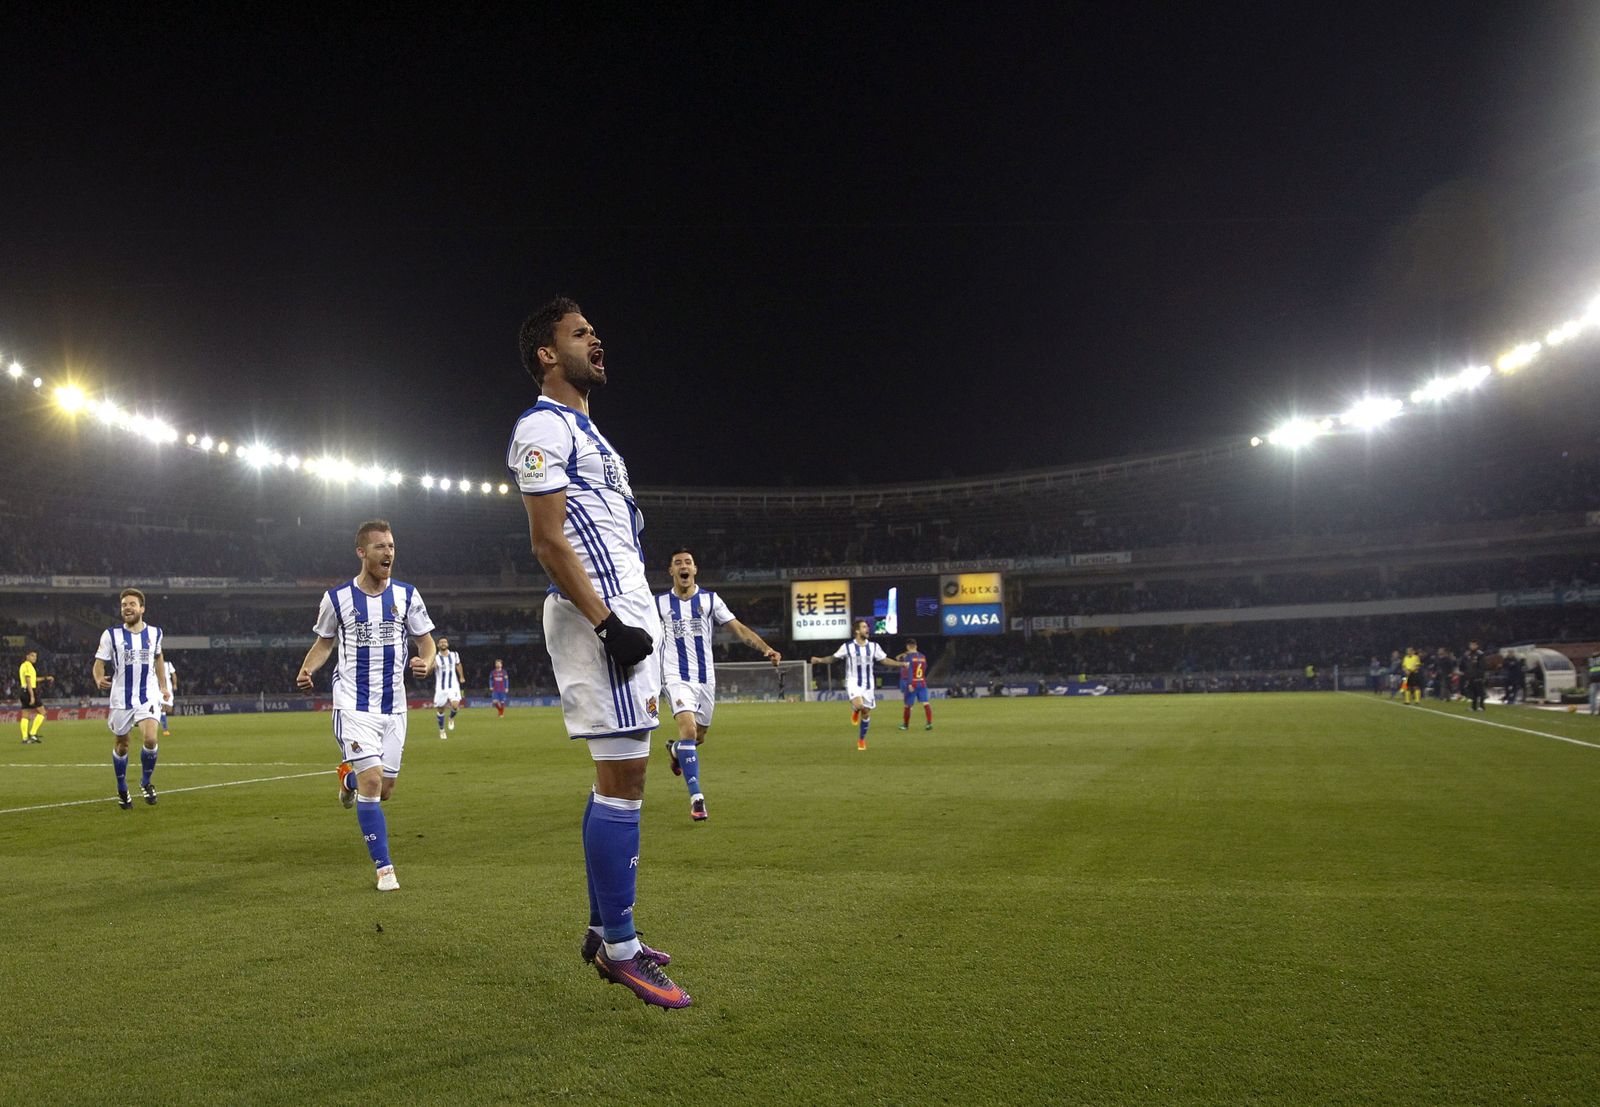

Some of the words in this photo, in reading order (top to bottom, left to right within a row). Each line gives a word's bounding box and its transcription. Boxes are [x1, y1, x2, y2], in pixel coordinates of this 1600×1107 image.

[797, 567, 828, 577] DIARIO
[829, 566, 856, 576] VASCO
[961, 585, 999, 596] kutxa
[796, 592, 845, 615] 钱宝
[796, 618, 846, 628] qbao.com
[961, 613, 999, 625] VASA
[916, 663, 923, 678] 6
[149, 705, 154, 714] 4
[183, 705, 205, 715] VASA
[364, 833, 377, 842] RS
